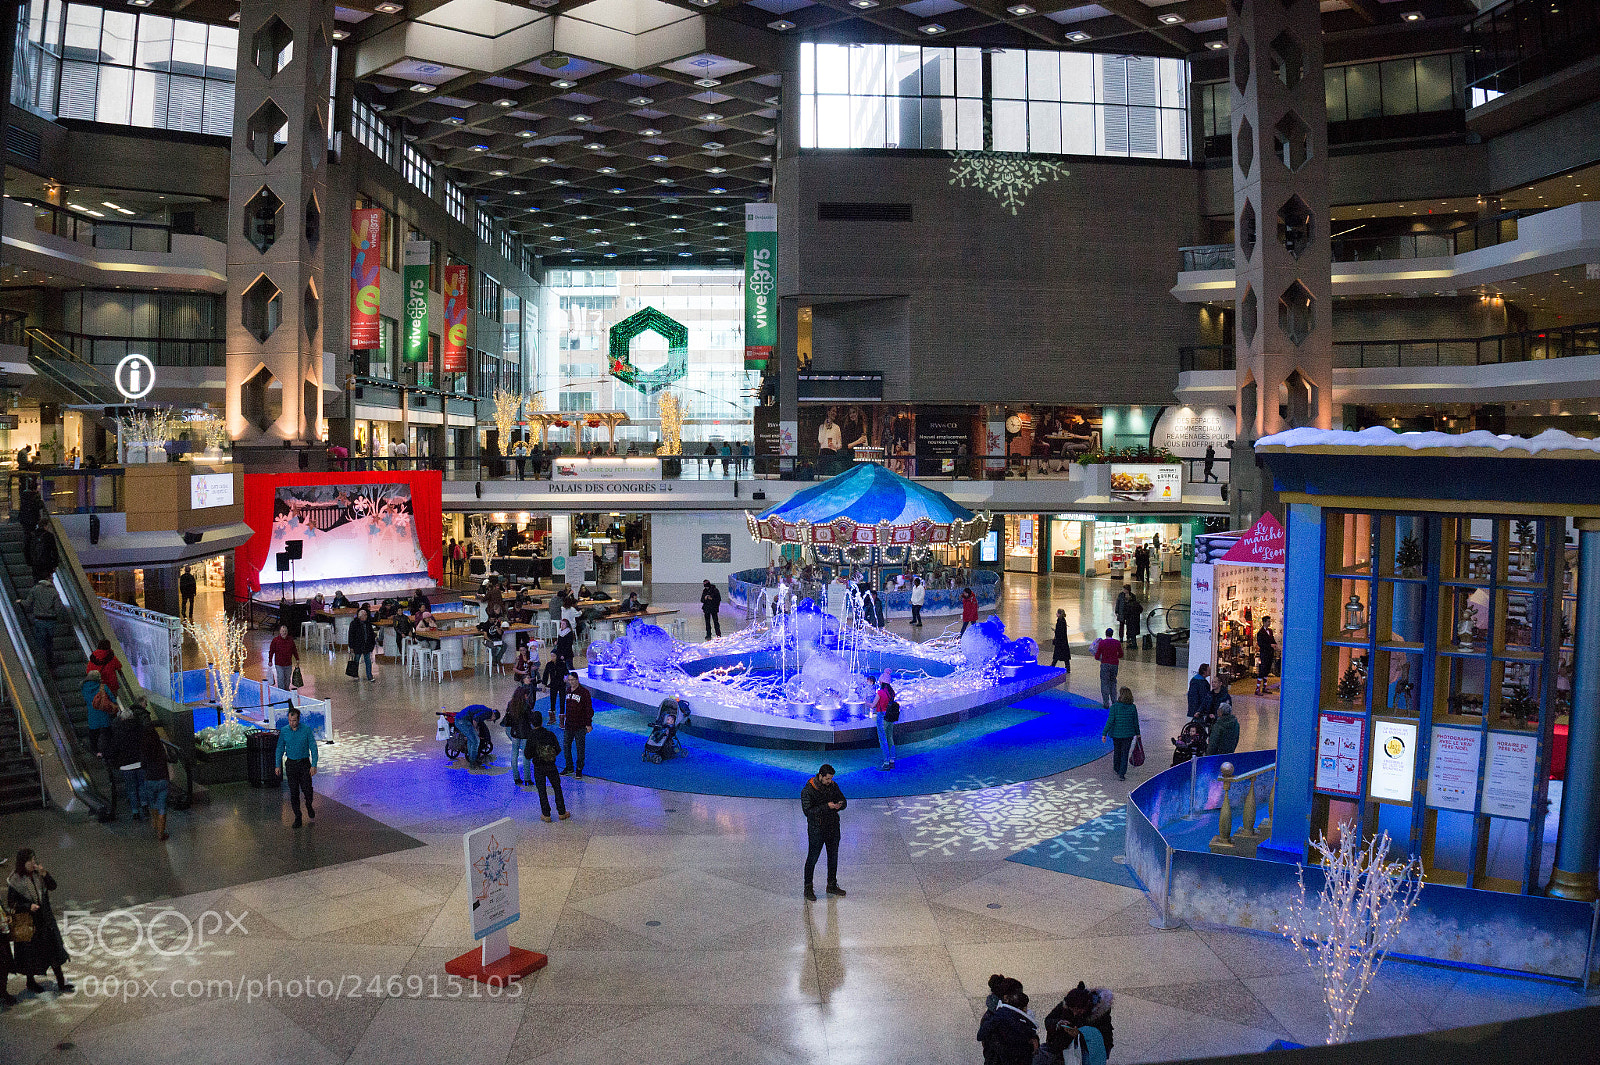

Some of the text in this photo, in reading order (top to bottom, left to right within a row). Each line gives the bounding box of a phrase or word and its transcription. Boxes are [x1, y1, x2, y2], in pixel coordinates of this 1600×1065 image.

[752, 248, 770, 328] vive 375
[409, 279, 424, 348] vive 375
[548, 482, 656, 492] PALAIS DES CONGRÈS
[1244, 527, 1284, 545] marché
[1254, 522, 1268, 536] Le
[1252, 543, 1264, 555] de
[1436, 734, 1475, 742] PHOTOGRAPHIE
